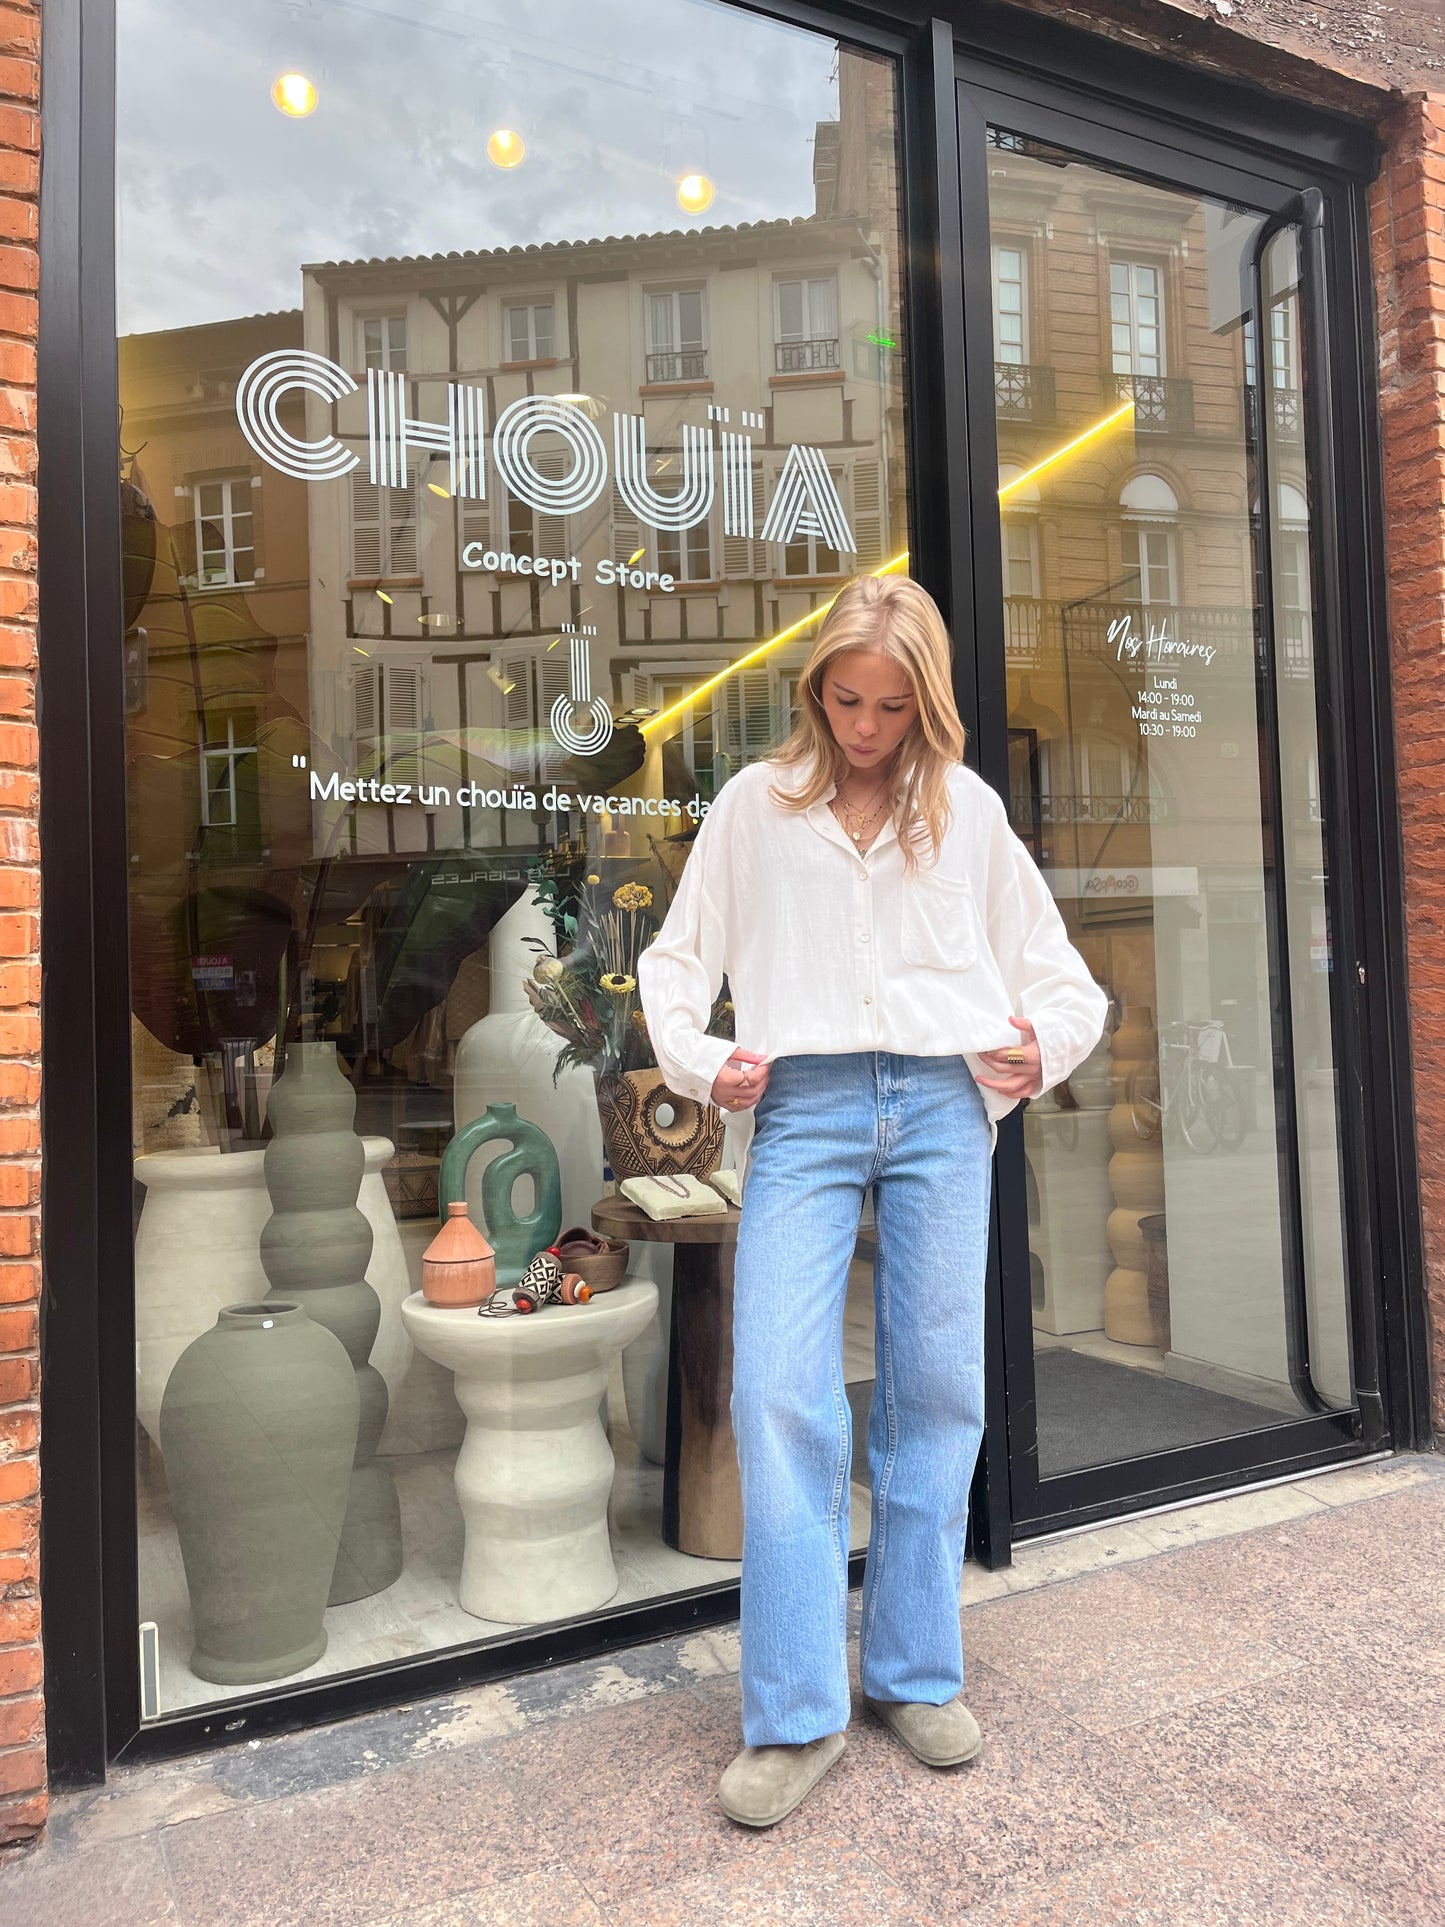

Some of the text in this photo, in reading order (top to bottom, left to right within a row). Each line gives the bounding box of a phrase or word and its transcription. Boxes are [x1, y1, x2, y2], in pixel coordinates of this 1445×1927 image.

[236, 349, 857, 553] CHOUÏA
[461, 541, 675, 592] Concept Store
[1107, 615, 1216, 665] Nos Horaires
[1153, 675, 1178, 690] Lundi
[1137, 691, 1162, 704] 14:00
[1170, 693, 1195, 706] 19:00
[1131, 706, 1202, 722] Mardi au Samedi
[1139, 723, 1164, 736] 10:30
[1171, 725, 1196, 738] 19:00
[419, 780, 450, 806] un
[456, 779, 536, 811] chouïa
[542, 785, 571, 812] de
[576, 795, 681, 818] vacances
